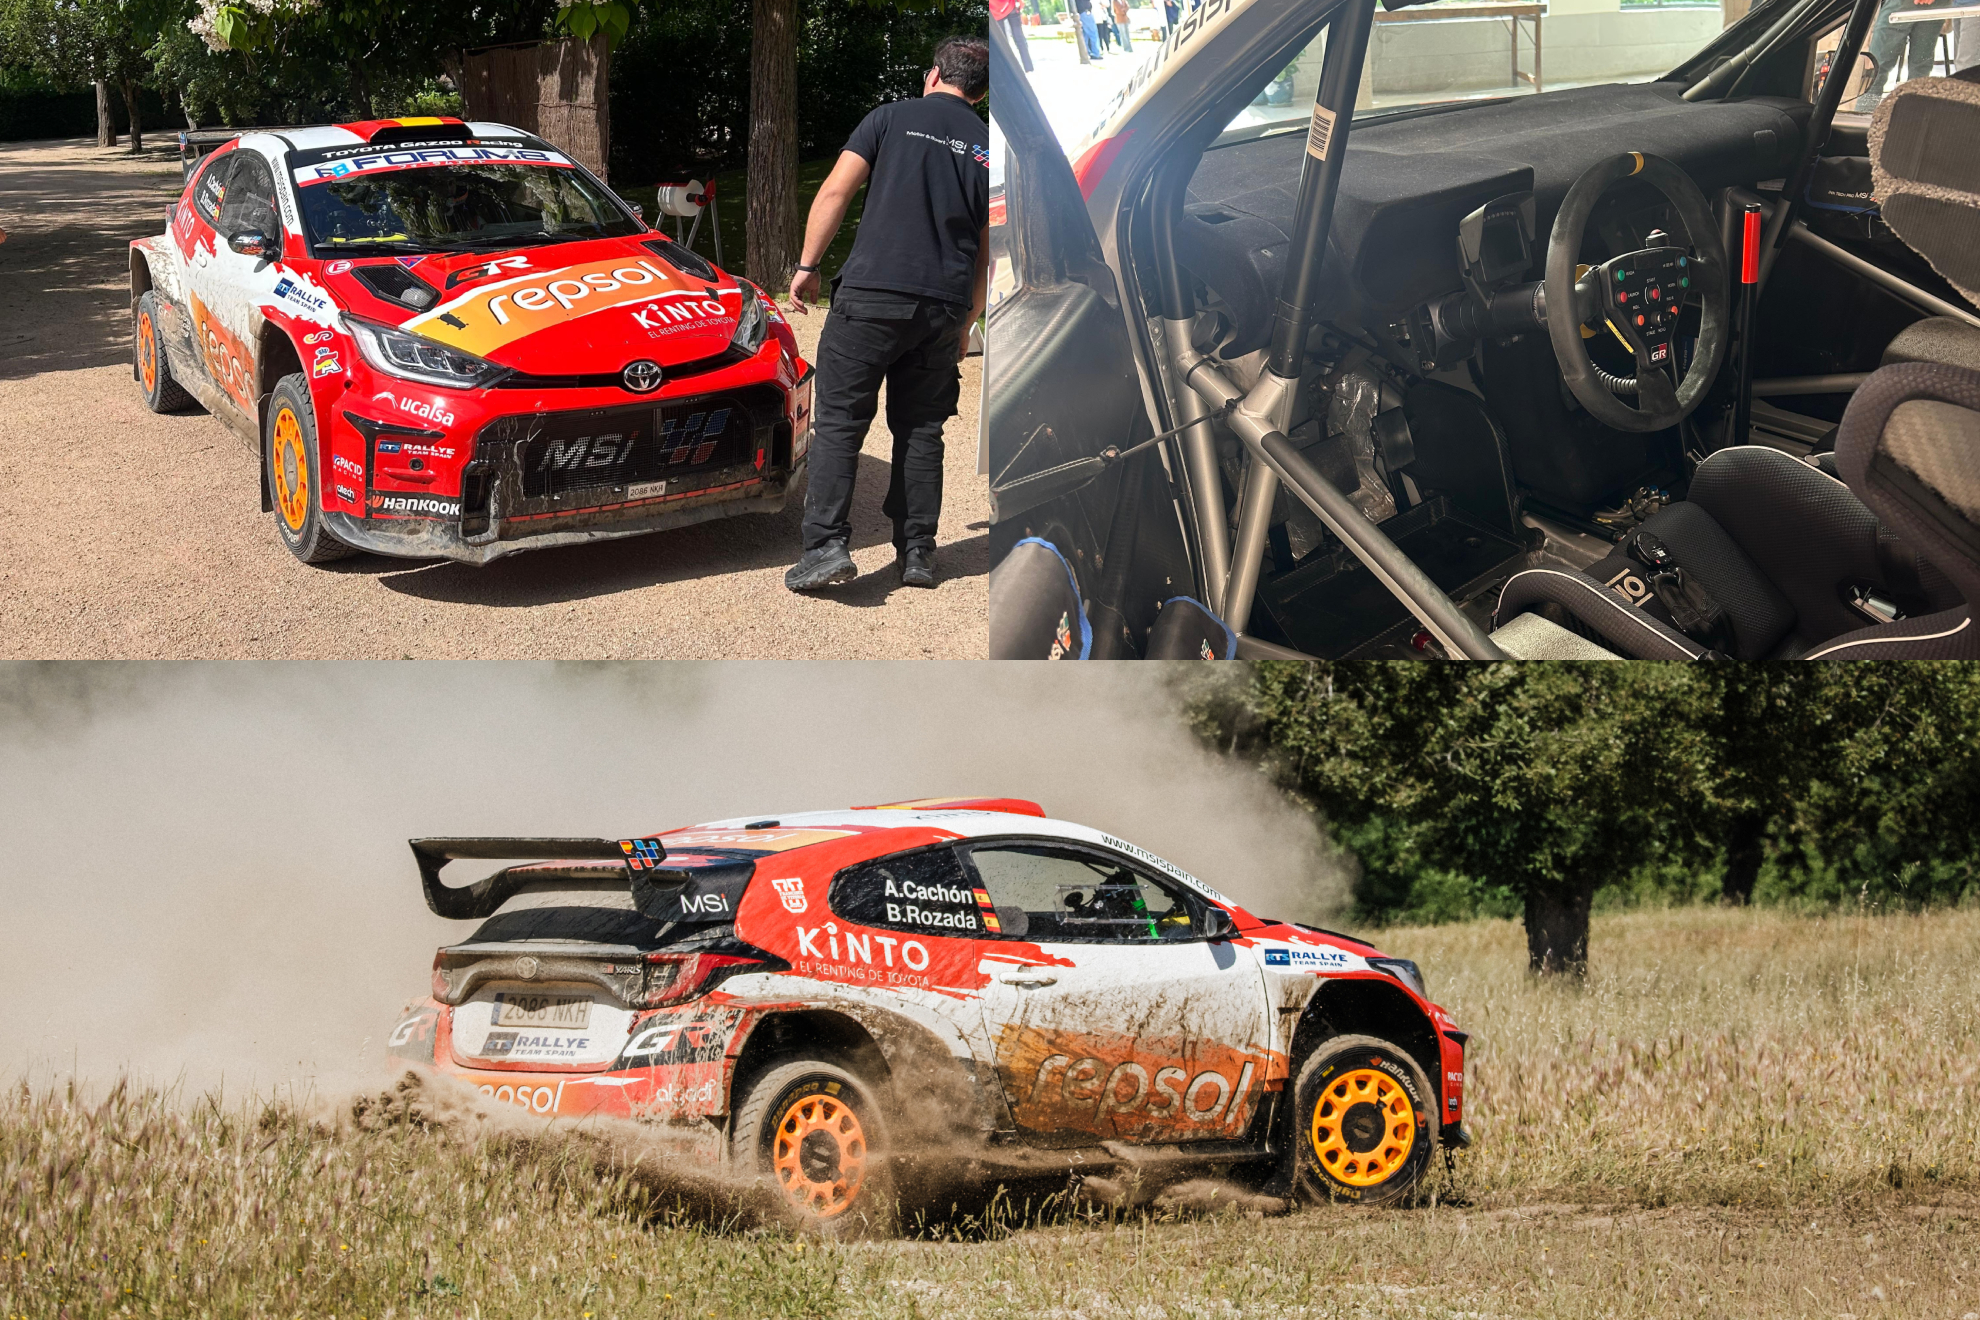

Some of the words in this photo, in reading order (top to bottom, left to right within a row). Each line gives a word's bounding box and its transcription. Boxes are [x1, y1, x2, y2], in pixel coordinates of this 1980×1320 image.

[321, 144, 396, 159] TOYOTA
[400, 140, 463, 148] GAZOO
[466, 139, 523, 148] Racing
[352, 148, 550, 170] FORUM8
[445, 255, 534, 291] GR
[277, 282, 291, 294] RTS
[289, 286, 327, 309] RALLYE
[487, 261, 669, 326] repsol
[287, 294, 300, 305] TEAM
[300, 301, 317, 313] SPAIN
[648, 330, 661, 339] EL
[659, 322, 696, 336] RENTING
[694, 320, 708, 328] DE
[706, 316, 737, 325] TOYOTA
[1651, 349, 1667, 360] GR
[400, 396, 455, 426] ucalsa
[403, 443, 456, 455] RALLYE
[340, 456, 363, 476] PACID
[630, 485, 648, 497] 2086
[649, 482, 664, 494] NKH
[1100, 833, 1222, 900] www.msispain.com
[884, 879, 973, 905] A.Cachón
[886, 903, 977, 930] B.Rozada
[1265, 953, 1290, 961] RTS
[1291, 951, 1348, 962] RALLYE
[615, 965, 641, 975] YARIS
[799, 961, 813, 973] EL
[815, 962, 865, 979] RENTING
[868, 969, 884, 982] DE
[886, 971, 929, 987] TOYOTA
[504, 996, 549, 1021] 2086
[552, 998, 589, 1023] NKH
[389, 1013, 437, 1047] GR
[622, 1023, 711, 1056] GR
[484, 1039, 515, 1050] RTS
[516, 1036, 590, 1049] RALLYE
[1027, 1053, 1255, 1124] repsol
